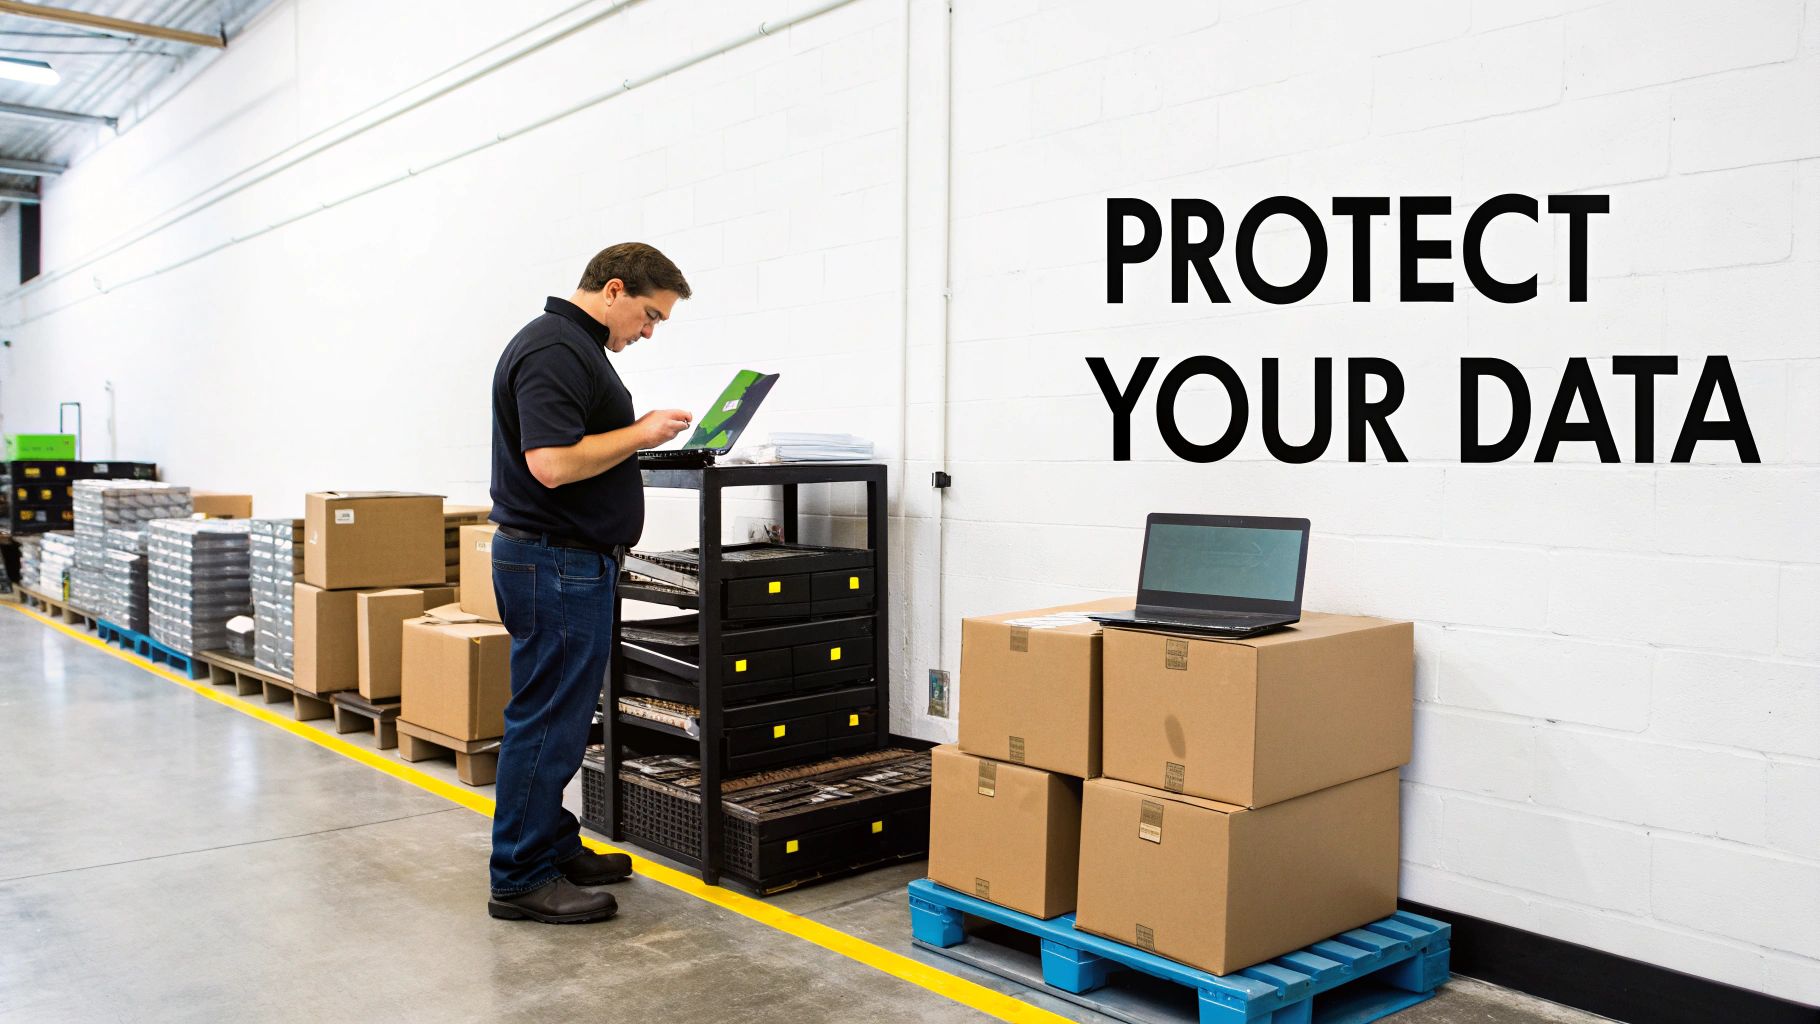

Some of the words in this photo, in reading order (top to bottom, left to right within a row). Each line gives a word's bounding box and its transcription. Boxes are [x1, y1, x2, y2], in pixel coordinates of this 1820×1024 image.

[1106, 194, 1610, 304] PROTECT
[1085, 356, 1409, 464] YOUR
[1460, 355, 1762, 464] DATA
